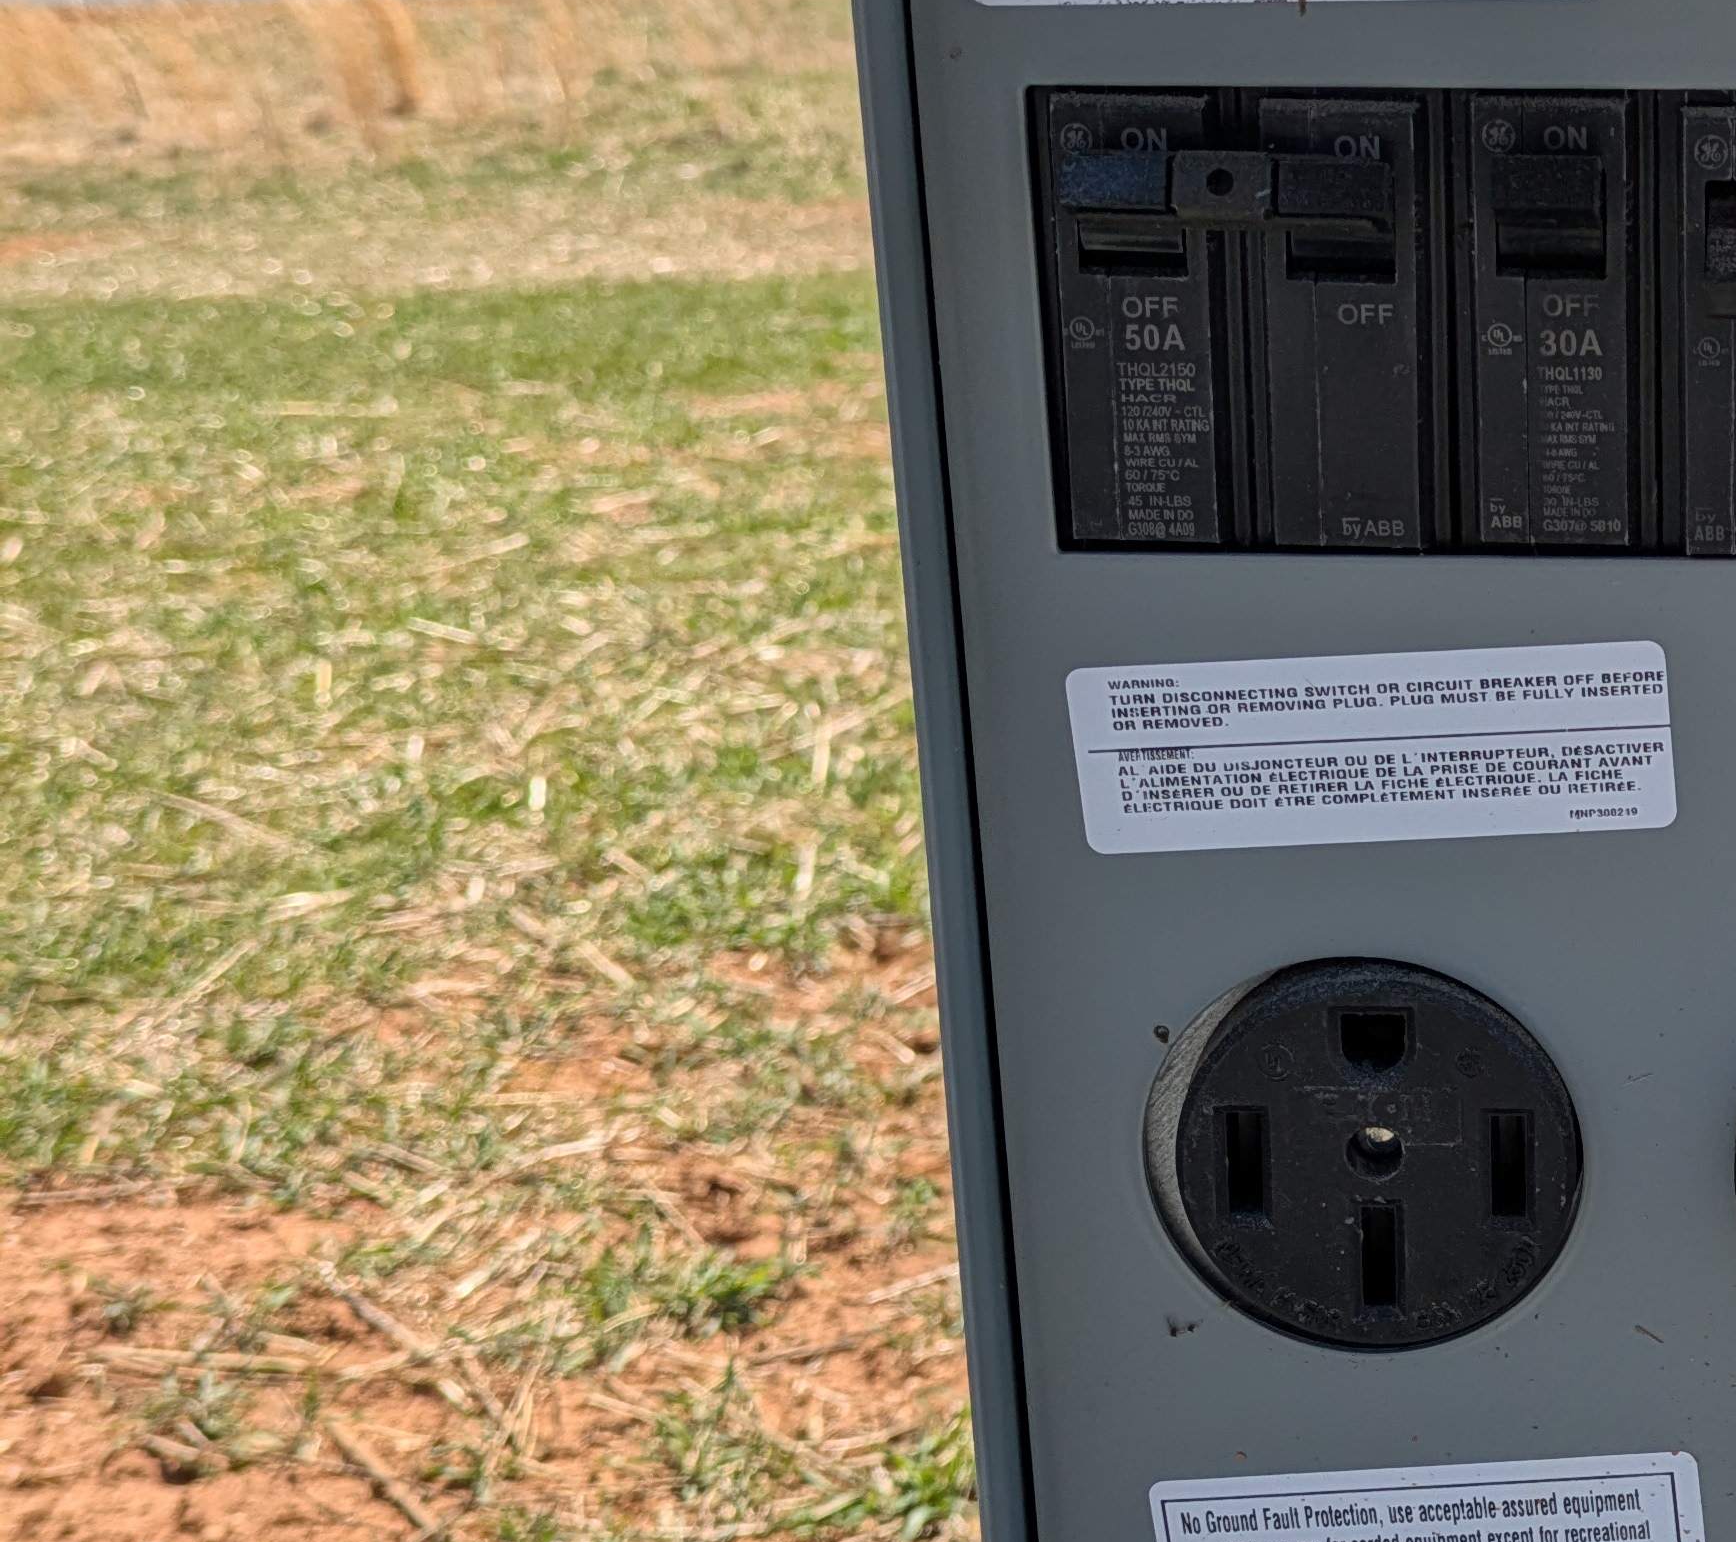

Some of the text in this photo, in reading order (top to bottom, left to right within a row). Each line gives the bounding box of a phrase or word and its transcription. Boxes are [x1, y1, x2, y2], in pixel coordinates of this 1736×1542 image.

[1121, 127, 1167, 152] ON
[1334, 135, 1380, 159] ON
[1544, 126, 1588, 150] ON
[1122, 297, 1179, 318] OFF
[1337, 304, 1393, 325] OFF
[1543, 294, 1600, 317] OFF
[1125, 324, 1185, 351] 50A
[1539, 329, 1603, 356] 30A
[1116, 363, 1196, 377] THQL2150
[1119, 379, 1195, 392] TYPE THQL
[1121, 394, 1176, 403] HACR
[1363, 520, 1405, 536] ABB
[1491, 515, 1523, 529] ABB
[1694, 526, 1725, 541] ABB
[1108, 679, 1179, 690] WARNING:
[1109, 670, 1665, 706] TURN DISCONNECTING SWITCH OR CIRCUIT BREAKER OFF BEFORE
[1112, 684, 1664, 718] INSERTING OR REMOVING PLUG. PLUG MUST BE FULLY INSERTED
[1113, 718, 1229, 730] OR REMOVED.
[1181, 1490, 1642, 1535] No Ground Fault Protection, use acceptable assured equipment
